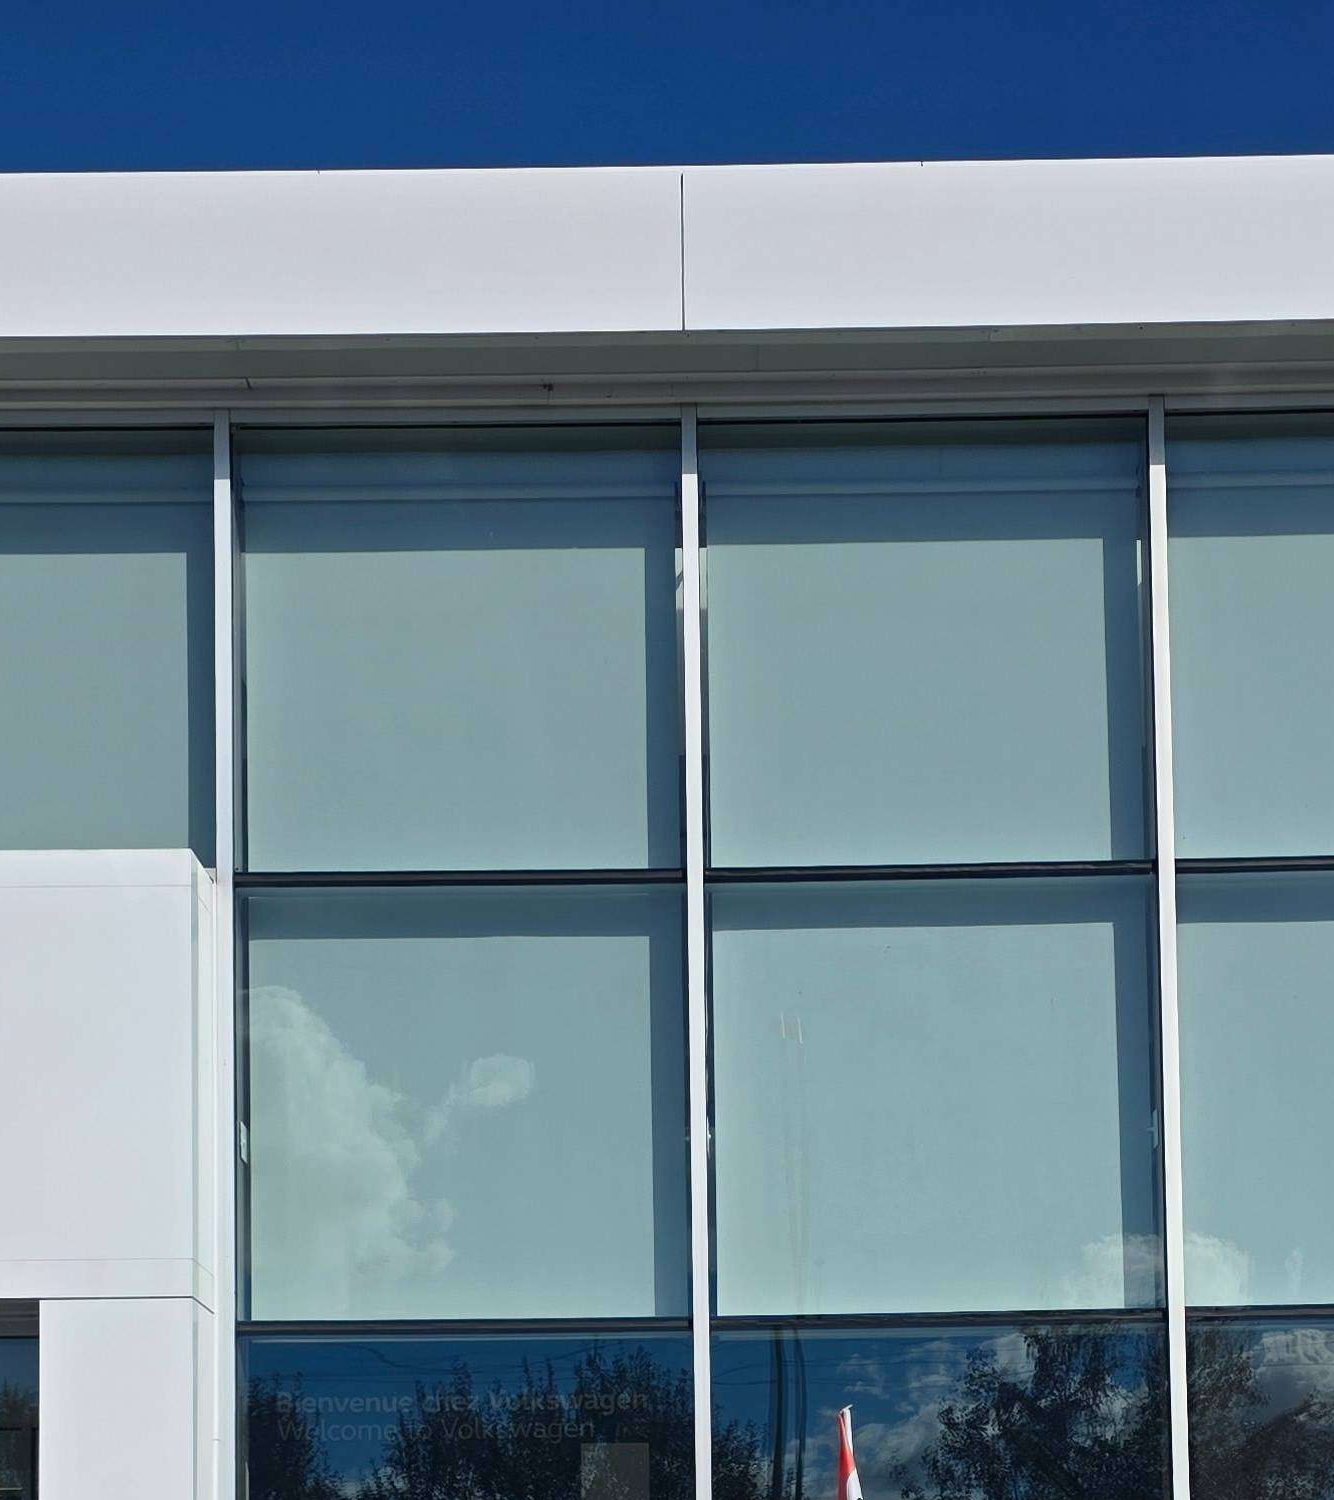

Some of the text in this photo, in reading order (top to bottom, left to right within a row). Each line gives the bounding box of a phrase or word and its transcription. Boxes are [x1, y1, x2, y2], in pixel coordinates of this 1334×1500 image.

[276, 1390, 649, 1416] Bienvenue chez Volkswagen
[277, 1417, 596, 1443] Welcome to Volkswagen
